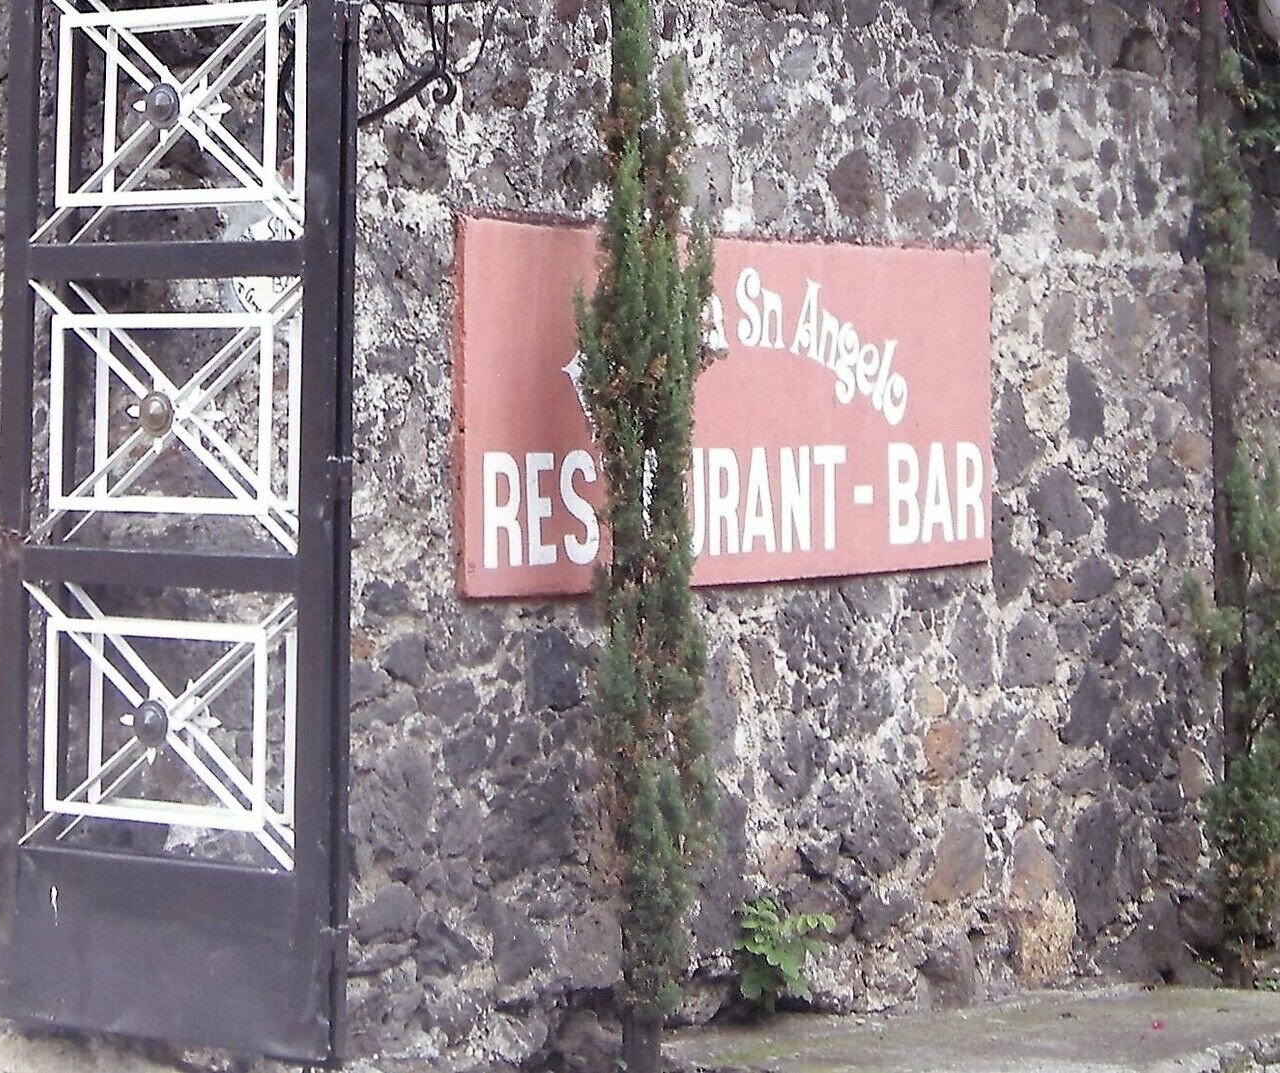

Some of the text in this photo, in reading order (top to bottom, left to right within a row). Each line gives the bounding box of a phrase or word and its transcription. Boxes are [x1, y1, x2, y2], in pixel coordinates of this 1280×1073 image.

[735, 267, 786, 348] Sn
[789, 277, 909, 427] Angelo
[482, 444, 847, 570] RESURANT
[886, 440, 985, 546] BAR
